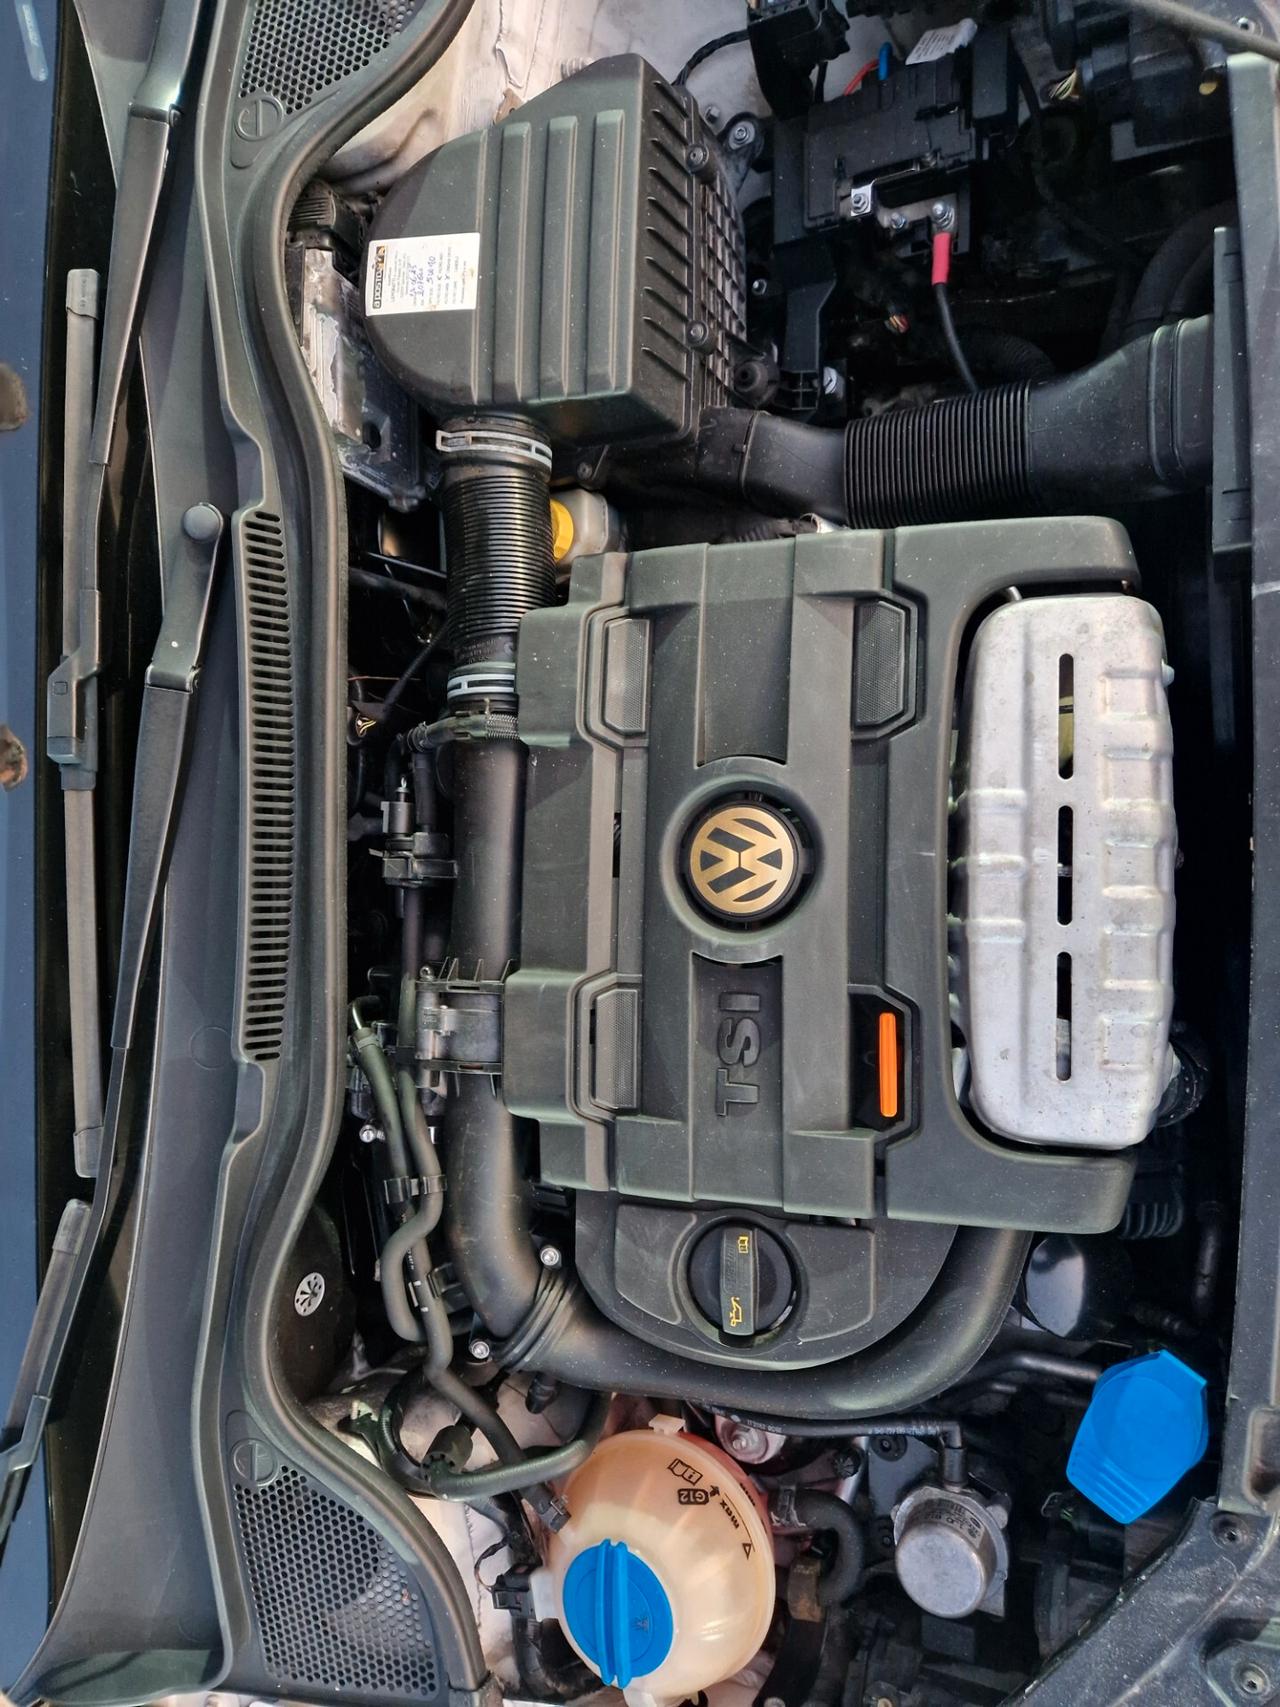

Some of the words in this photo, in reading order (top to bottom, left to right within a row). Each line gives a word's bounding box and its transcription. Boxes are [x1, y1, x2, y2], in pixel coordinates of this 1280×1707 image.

[690, 806, 794, 914] VW
[714, 991, 762, 1117] TSI
[679, 1490, 705, 1503] G12
[719, 1499, 740, 1529] max
